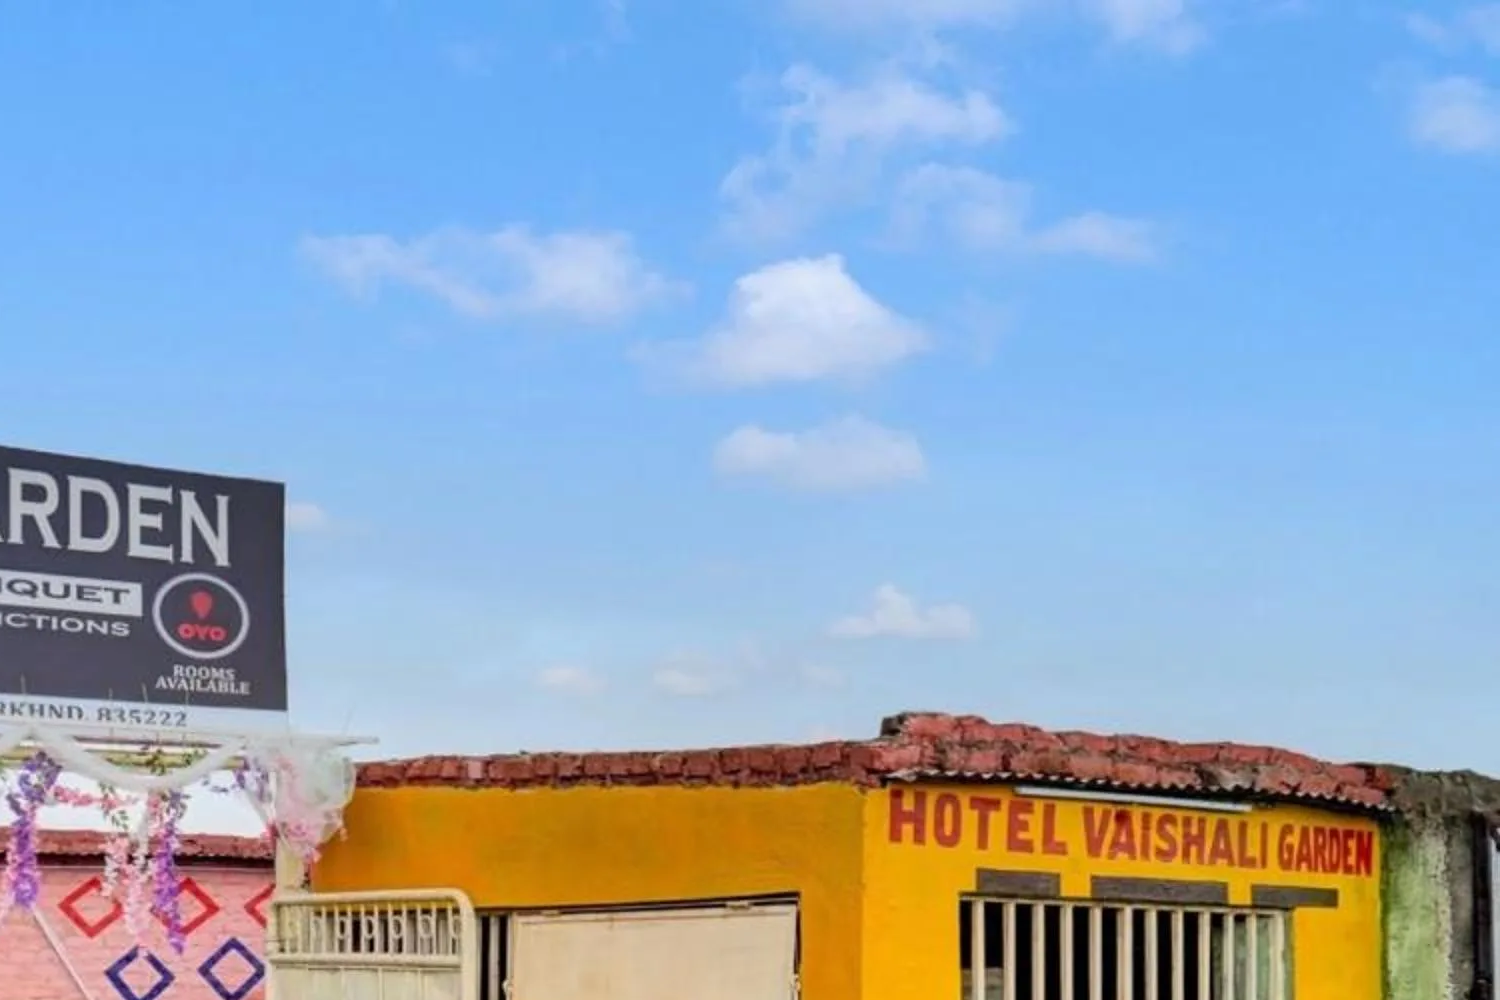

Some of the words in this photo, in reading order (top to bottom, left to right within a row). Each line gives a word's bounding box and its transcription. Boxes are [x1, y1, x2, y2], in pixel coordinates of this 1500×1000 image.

[177, 622, 228, 641] OYO
[173, 663, 236, 681] ROOMS
[155, 675, 251, 695] AVAILABLE
[888, 788, 1069, 857] HOTEL
[1277, 821, 1375, 878] GARDEN
